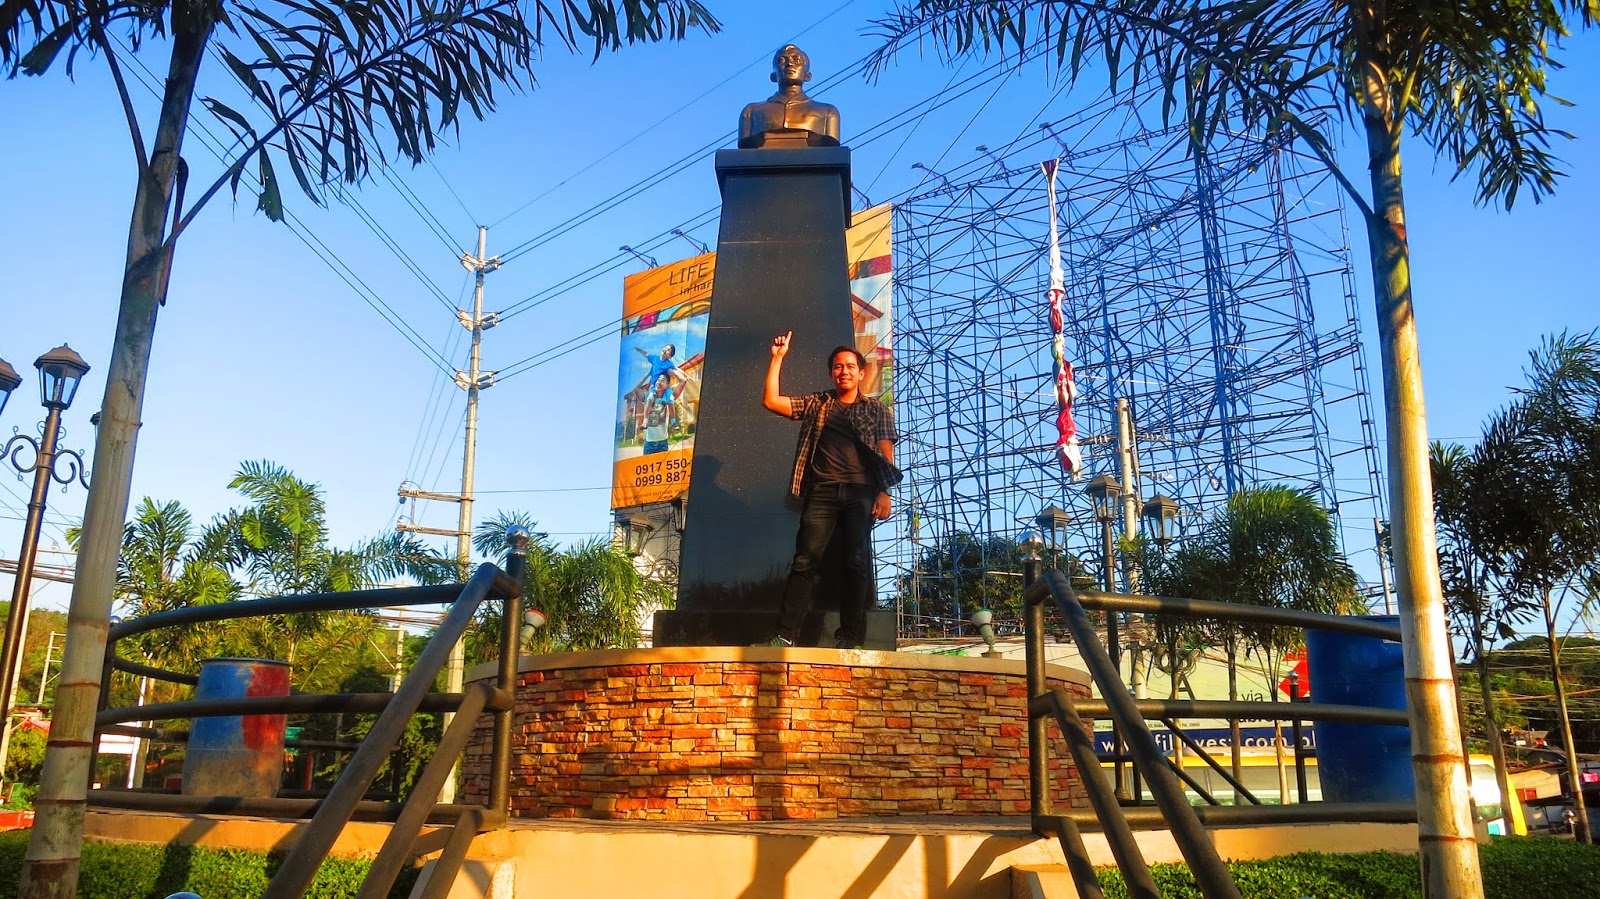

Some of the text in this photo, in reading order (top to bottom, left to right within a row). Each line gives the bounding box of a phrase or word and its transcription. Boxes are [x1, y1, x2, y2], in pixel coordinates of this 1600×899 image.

[669, 261, 709, 286] LIFE
[635, 462, 662, 475] 0917
[635, 473, 662, 487] 0999
[1241, 689, 1264, 702] via
